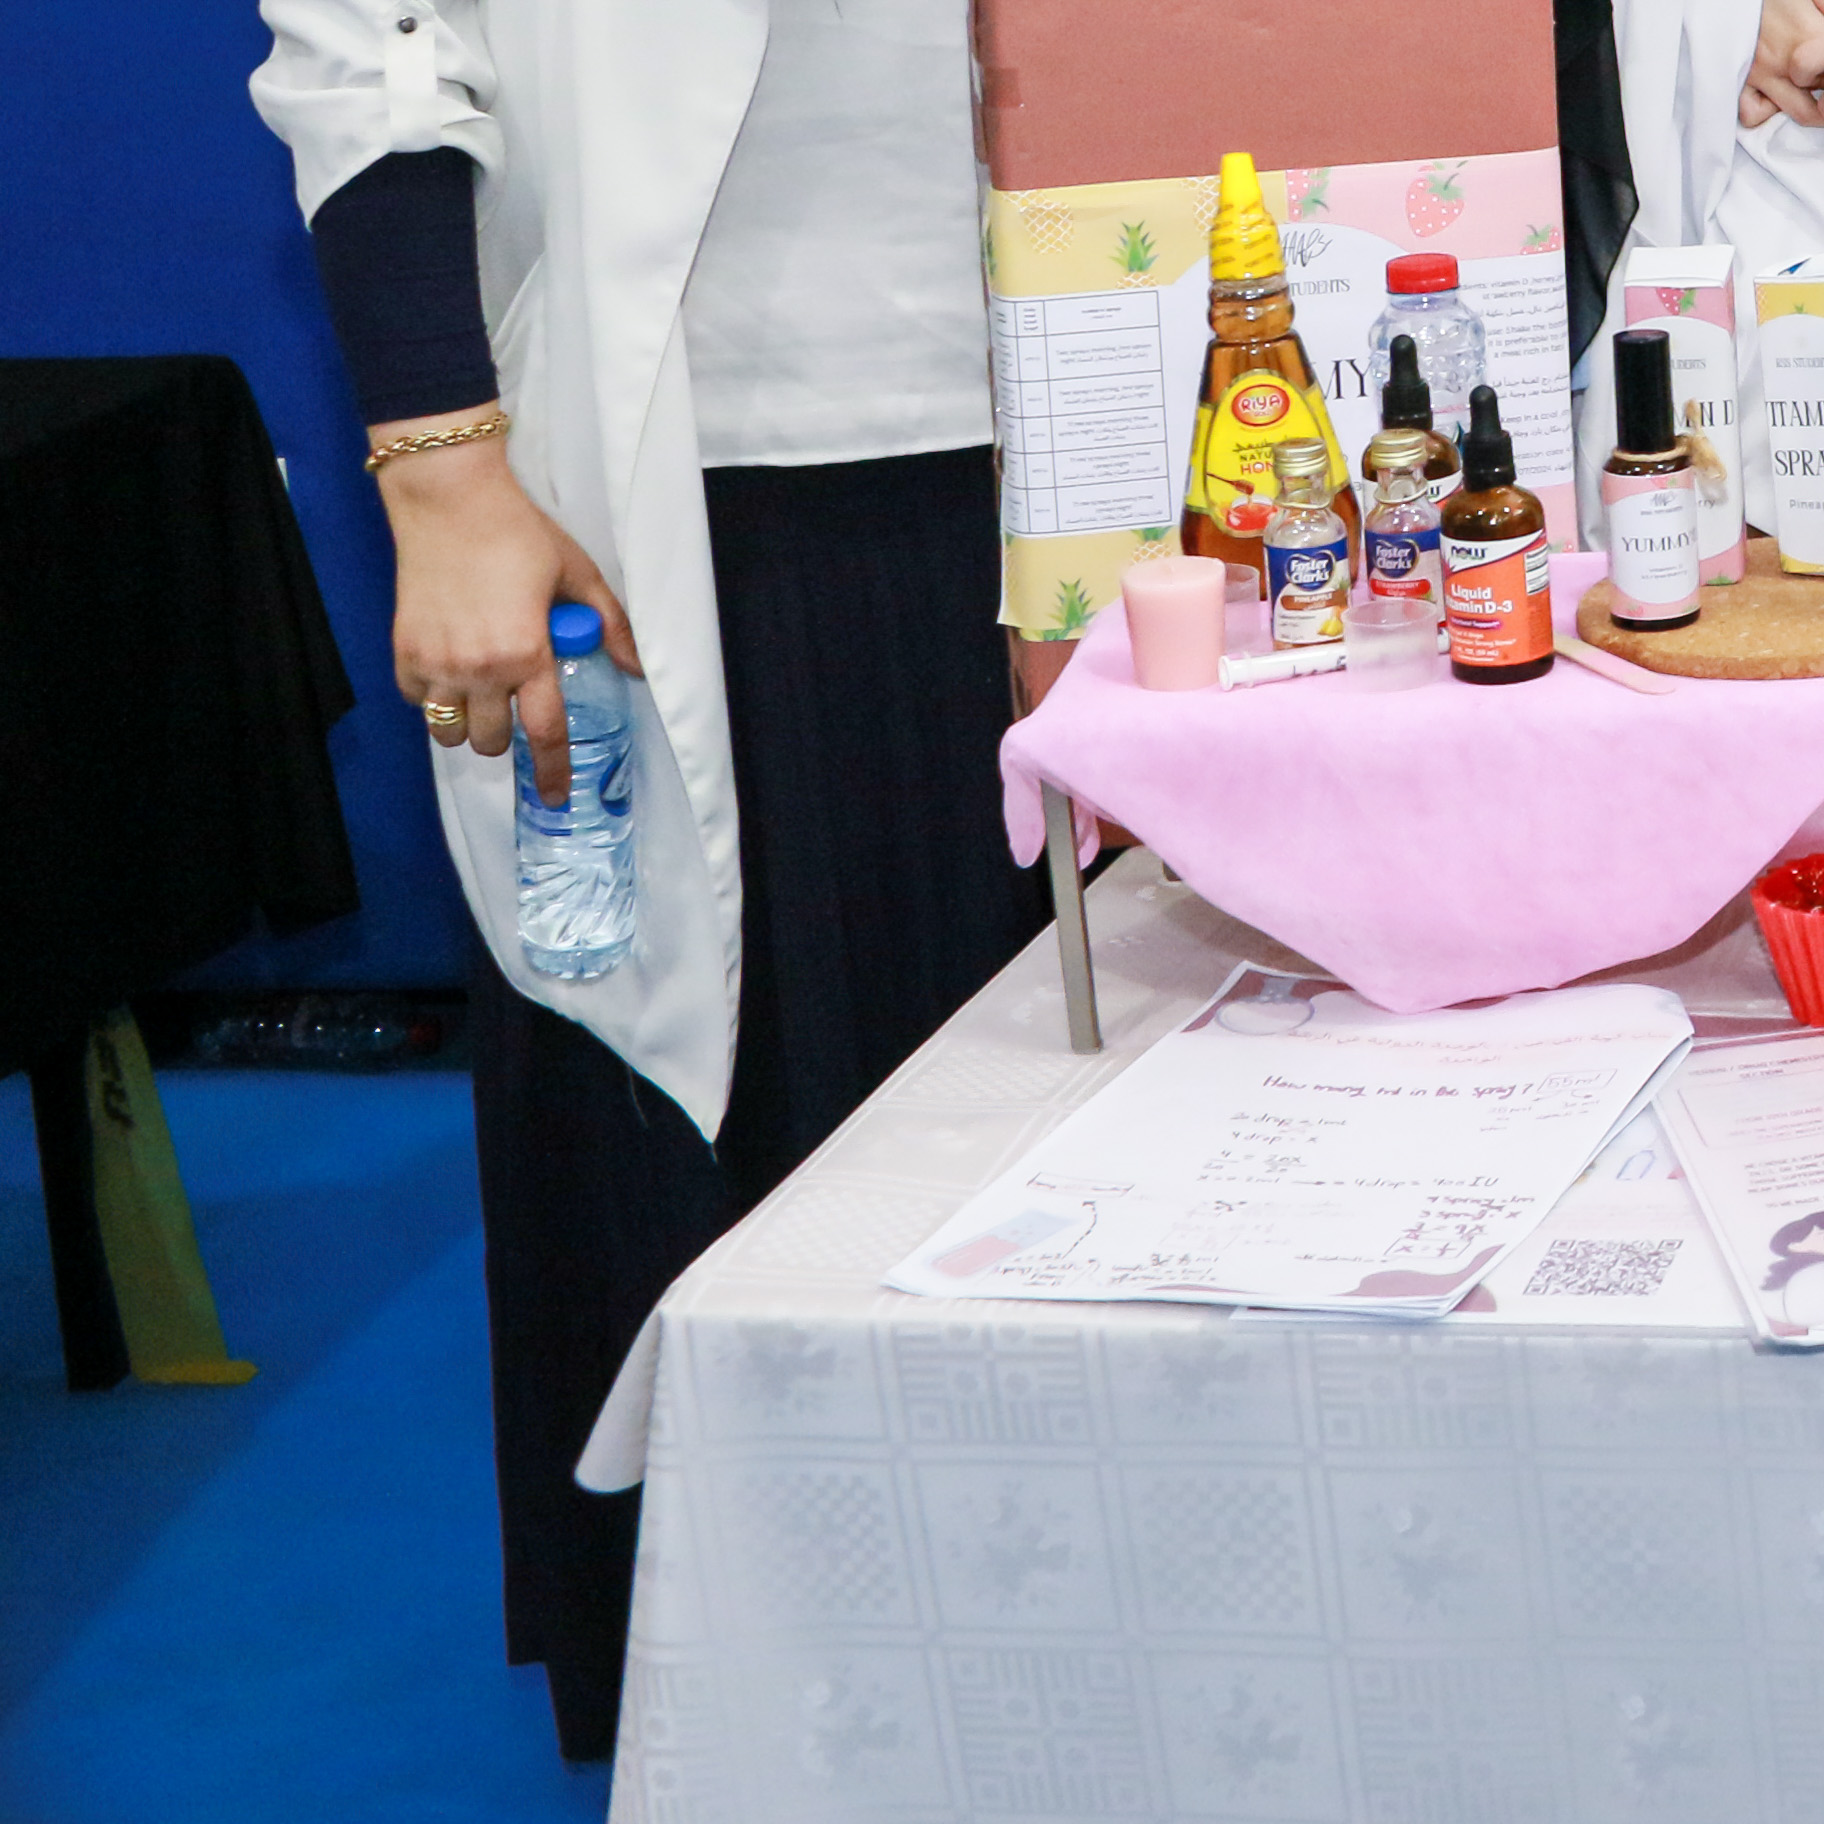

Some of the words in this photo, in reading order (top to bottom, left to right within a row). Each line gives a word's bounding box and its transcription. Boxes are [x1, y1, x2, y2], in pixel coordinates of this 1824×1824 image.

[1722, 398, 1735, 427] D
[1239, 452, 1276, 462] NATU
[1239, 461, 1276, 476] HON
[1375, 544, 1412, 558] Foster
[1289, 557, 1330, 572] Foster
[1290, 569, 1331, 585] Clark's
[1450, 583, 1492, 602] Liquid
[1485, 599, 1514, 614] D-3
[1261, 1073, 1308, 1092] How
